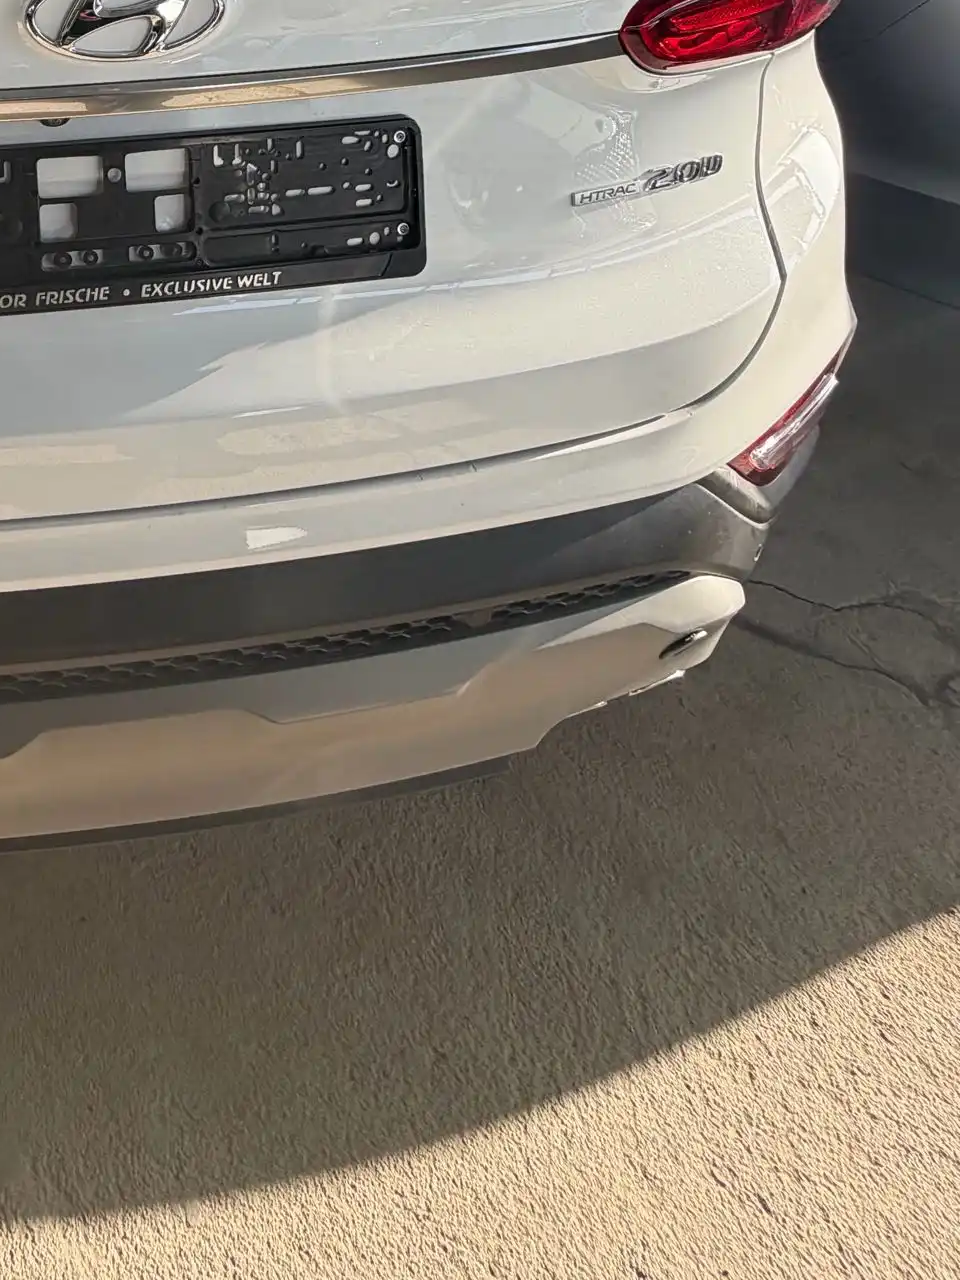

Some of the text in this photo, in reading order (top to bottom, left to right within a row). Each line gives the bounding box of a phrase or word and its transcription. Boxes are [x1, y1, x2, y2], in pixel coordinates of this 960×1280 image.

[579, 183, 637, 204] HTRAC
[35, 285, 110, 307] FRISCHE
[141, 276, 233, 299] EXCLUSIVE
[236, 270, 283, 288] WELT
